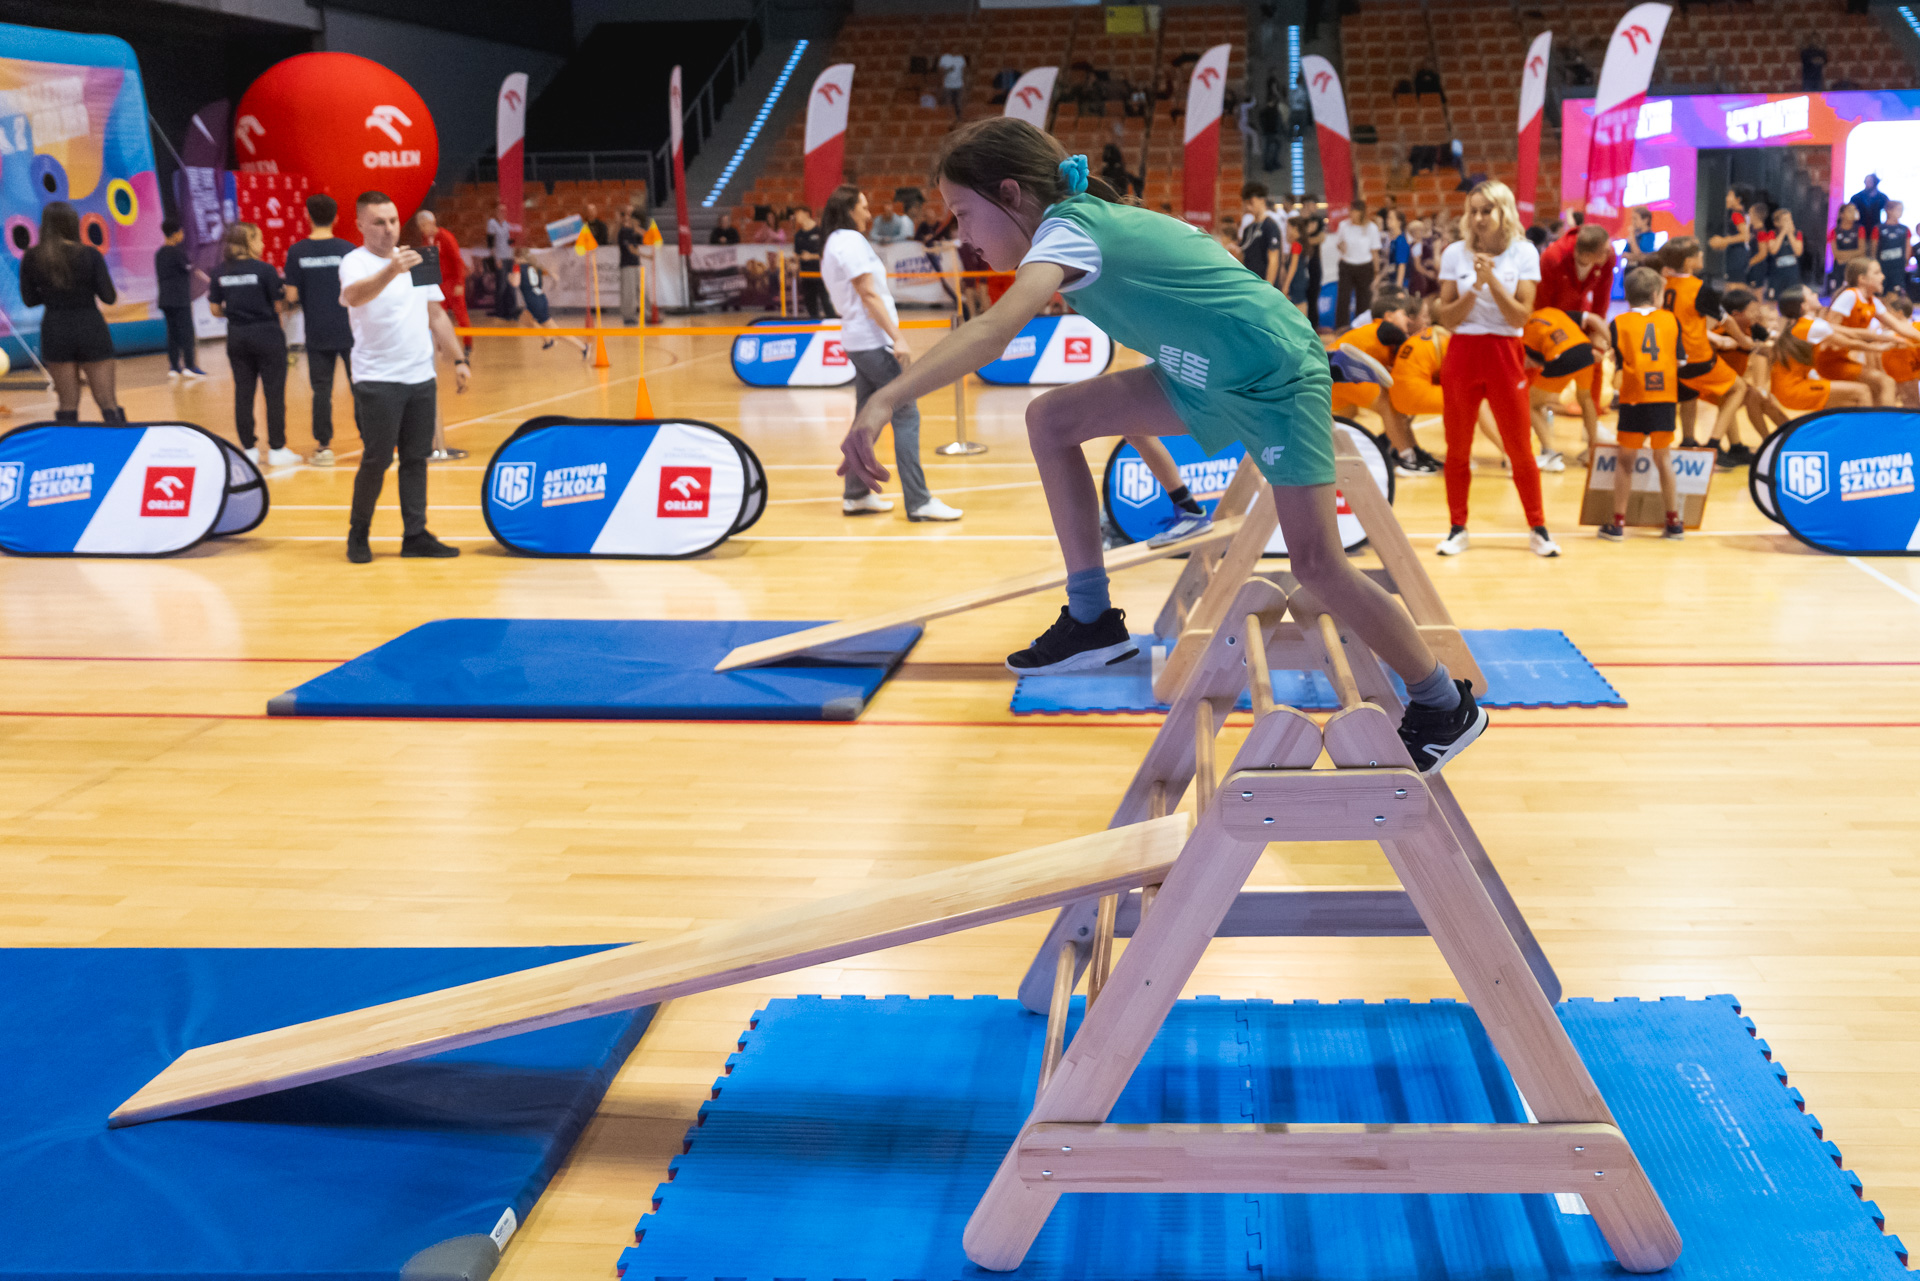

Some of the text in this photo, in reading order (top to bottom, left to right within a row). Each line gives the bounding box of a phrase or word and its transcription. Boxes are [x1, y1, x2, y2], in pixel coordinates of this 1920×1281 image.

[363, 150, 421, 169] ORLEN
[1642, 323, 1660, 361] 4
[1180, 457, 1239, 478] KTYWNA
[1261, 446, 1285, 466] 4F
[1839, 452, 1914, 476] AKTYWNA
[499, 466, 529, 503] AS
[543, 462, 607, 483] AKTYWNA
[1788, 456, 1822, 496] AS
[1839, 466, 1914, 493] SZKOŁA
[28, 475, 92, 500] SZKOŁA
[542, 475, 606, 500] SZKOŁA
[147, 499, 185, 511] ORLEN
[664, 500, 703, 511] ORLEN
